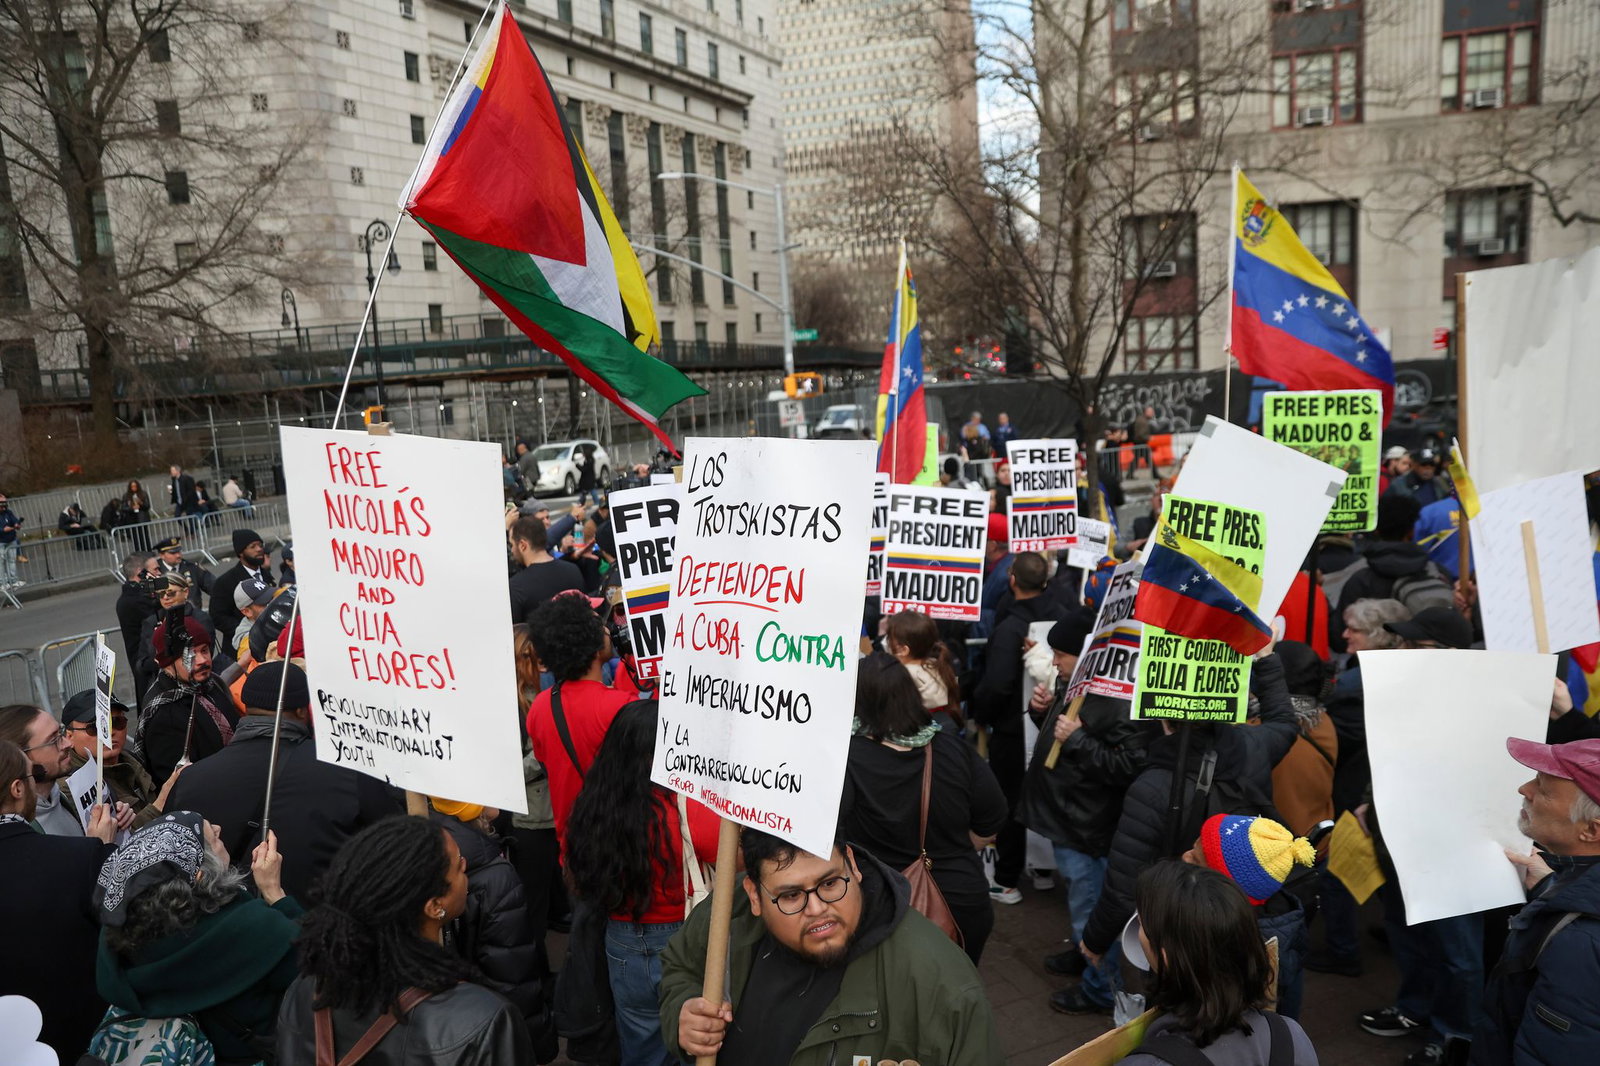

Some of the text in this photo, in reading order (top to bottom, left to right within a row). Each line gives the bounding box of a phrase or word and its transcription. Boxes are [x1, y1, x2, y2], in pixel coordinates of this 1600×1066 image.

[1273, 396, 1379, 417] FREE PRES.
[1273, 422, 1372, 443] MADURO &
[325, 442, 388, 488] FREE
[688, 452, 727, 494] LOS
[1011, 448, 1072, 465] FREE
[1013, 468, 1074, 492] PRESIDENT
[324, 486, 431, 537] NICOLÁS
[694, 494, 841, 543] TROTSKISTAS
[890, 494, 984, 518] FREE
[1168, 499, 1263, 550] FREE PRES.
[888, 520, 985, 550] PRESIDENT
[331, 538, 424, 587] MADURO
[677, 555, 805, 605] DEFIENDEN
[358, 582, 395, 605] AND
[884, 571, 981, 605] MADURO
[339, 603, 402, 648] CILIA
[673, 613, 686, 648] A
[755, 621, 845, 672] CONTRA
[1147, 635, 1182, 659] FIRST
[348, 646, 457, 691] FLORES!
[1146, 661, 1241, 694] CILIA FLORES
[317, 689, 431, 734] REVOLUTIONARY
[662, 665, 812, 723] EL IMPERIALISMO
[661, 718, 689, 747] Y LA
[1144, 708, 1185, 719] WORKERS
[1210, 712, 1234, 721] PARTY
[324, 714, 453, 760] INTERNATIONALIST
[330, 740, 375, 767] YOUTH
[665, 748, 802, 794] CONTRARREVOLUCIÓN
[667, 773, 695, 794] GRUPO
